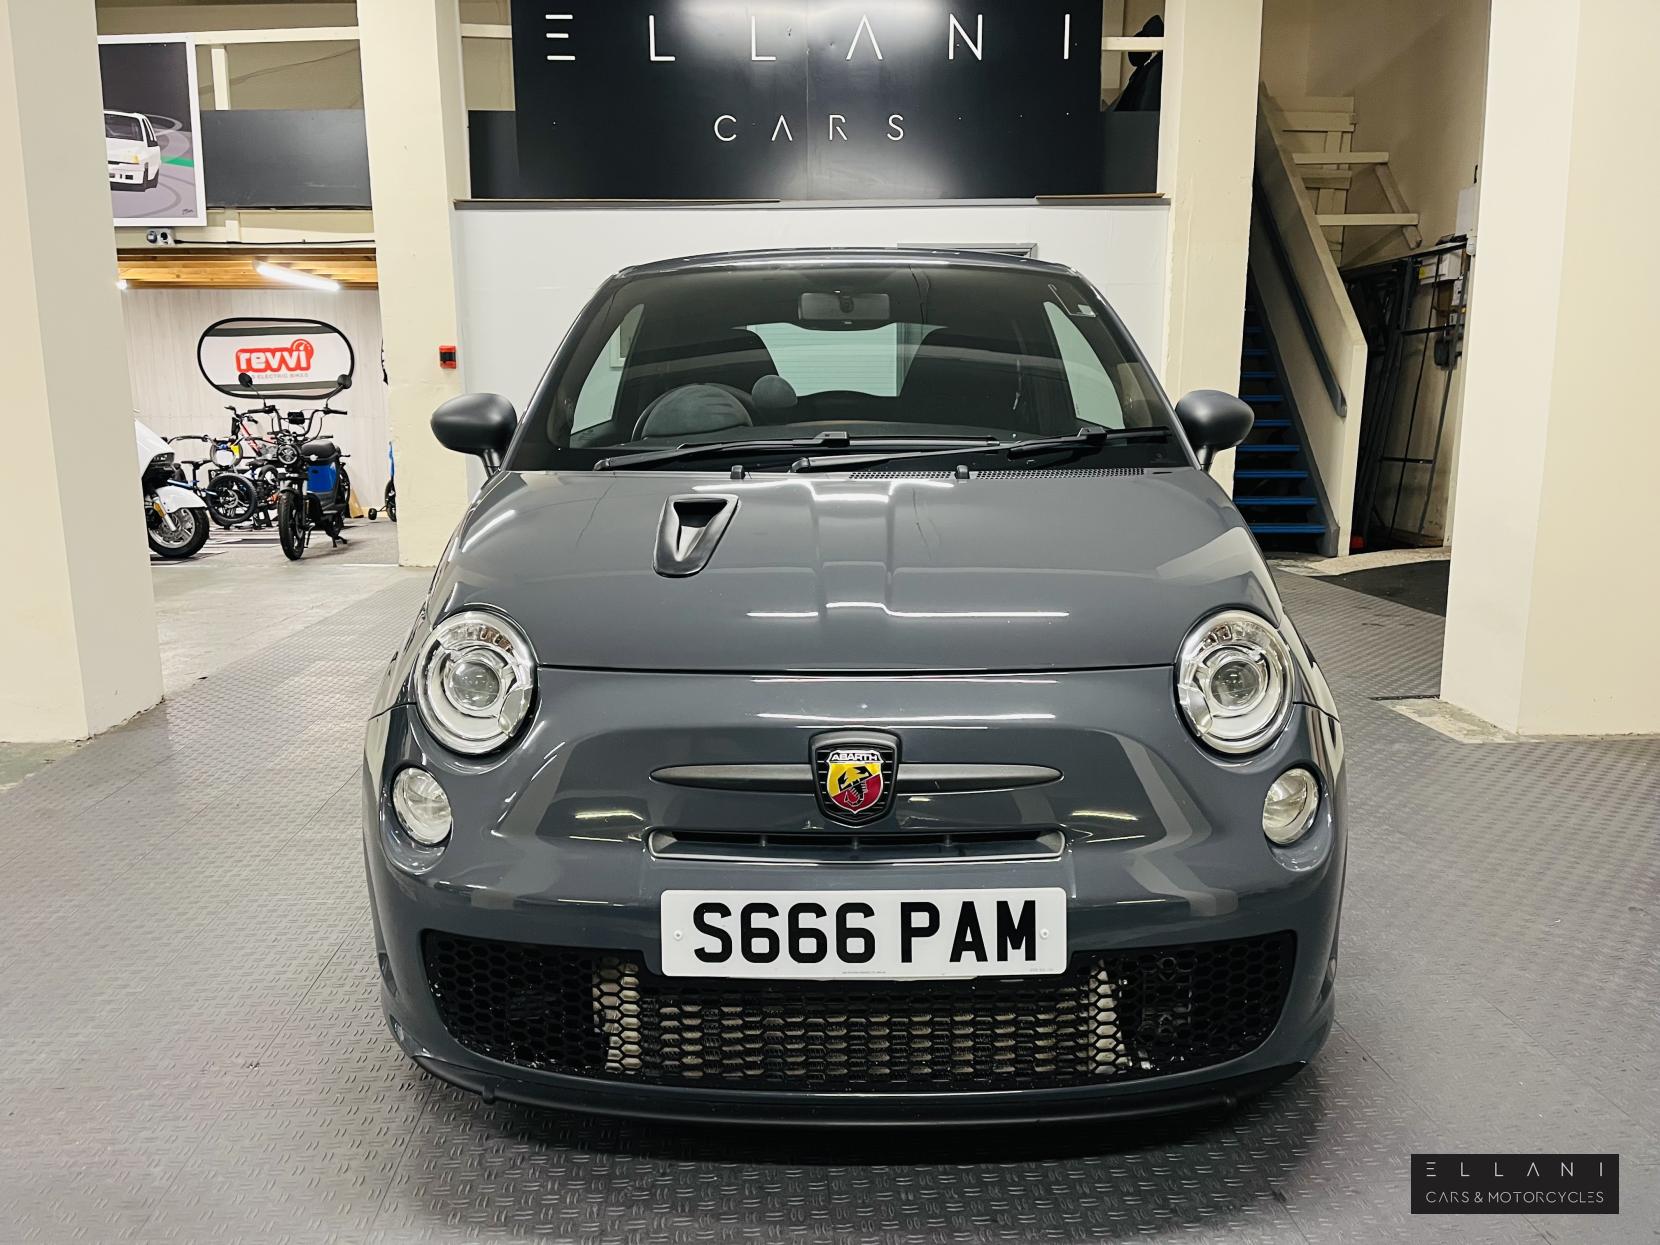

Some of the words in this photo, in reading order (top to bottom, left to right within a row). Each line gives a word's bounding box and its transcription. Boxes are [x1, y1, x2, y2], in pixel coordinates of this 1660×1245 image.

[545, 14, 1070, 61] ELLANI
[714, 114, 904, 142] CARS
[239, 343, 308, 370] revvi
[831, 753, 878, 762] ABARTH
[692, 902, 876, 964] S666
[900, 899, 1037, 964] PAM
